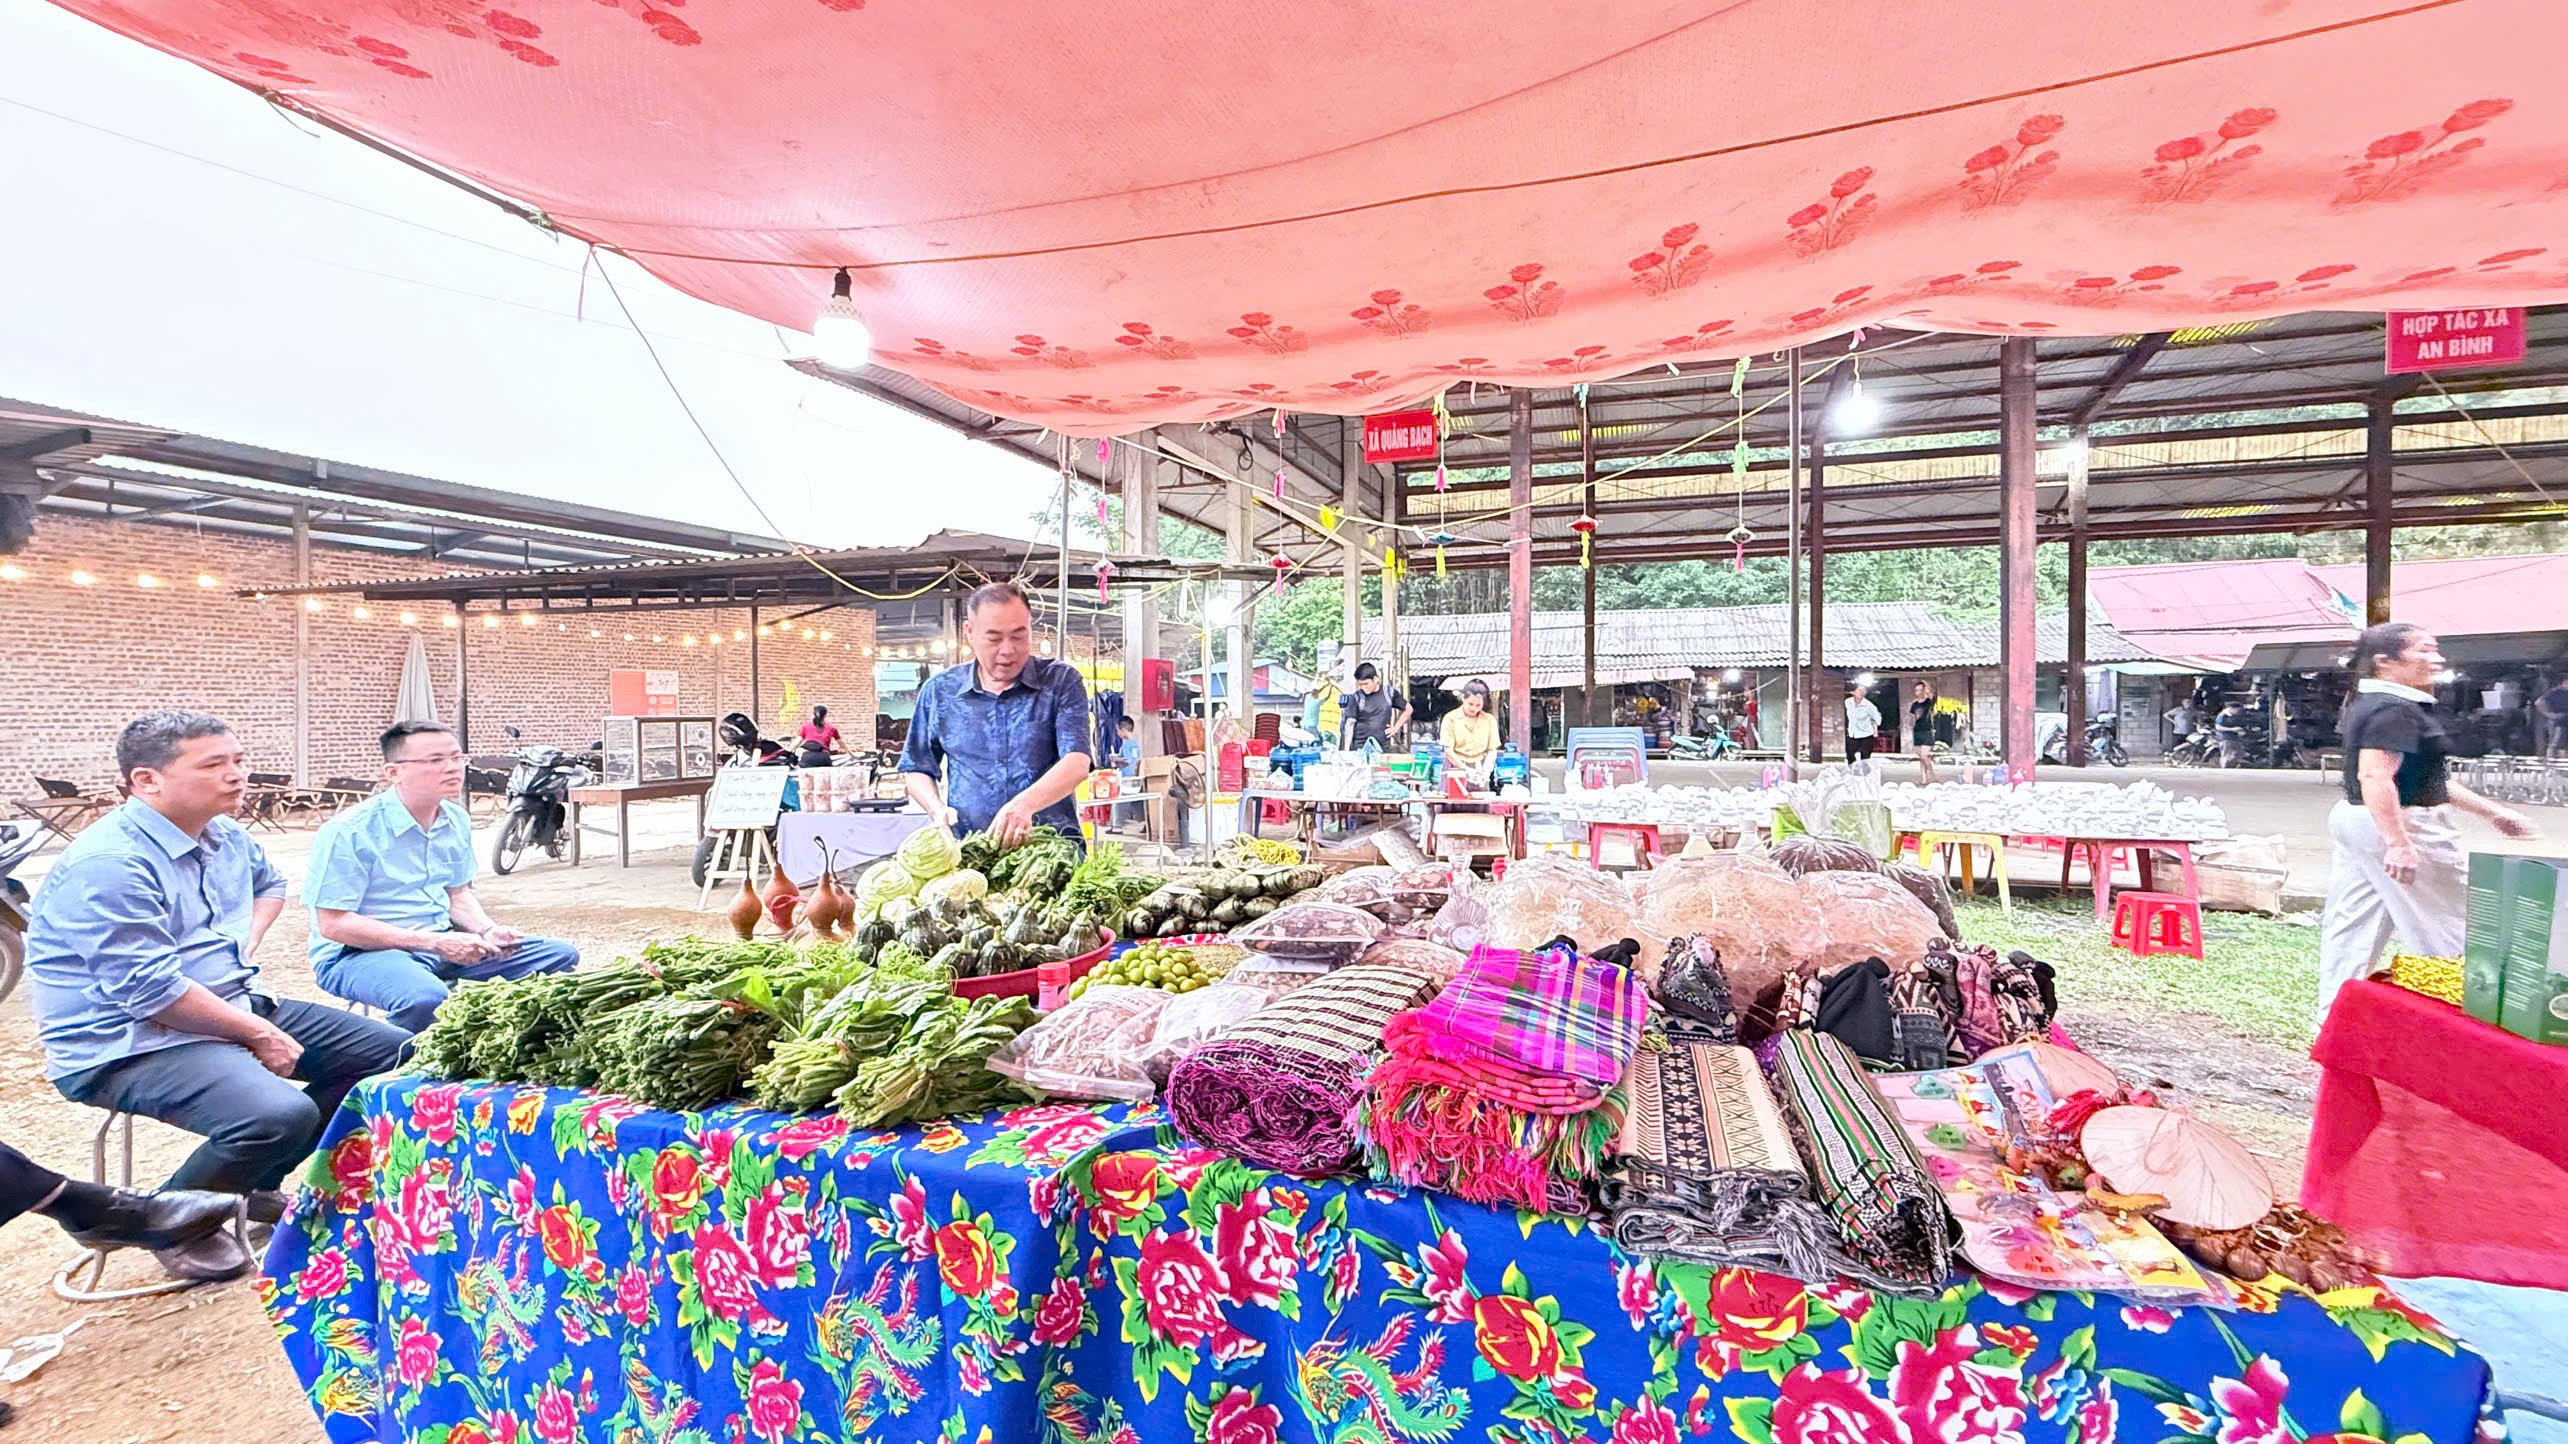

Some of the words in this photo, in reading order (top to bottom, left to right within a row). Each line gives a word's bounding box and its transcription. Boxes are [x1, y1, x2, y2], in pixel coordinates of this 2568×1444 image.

[2402, 315, 2439, 338] HỢP
[2443, 310, 2479, 331] TÁC
[2417, 341, 2444, 359] AN
[2448, 335, 2494, 357] BÌNH
[1368, 427, 1380, 452] XÃ
[1381, 422, 1409, 453] QUẢNG
[1410, 425, 1433, 452] BẠCH
